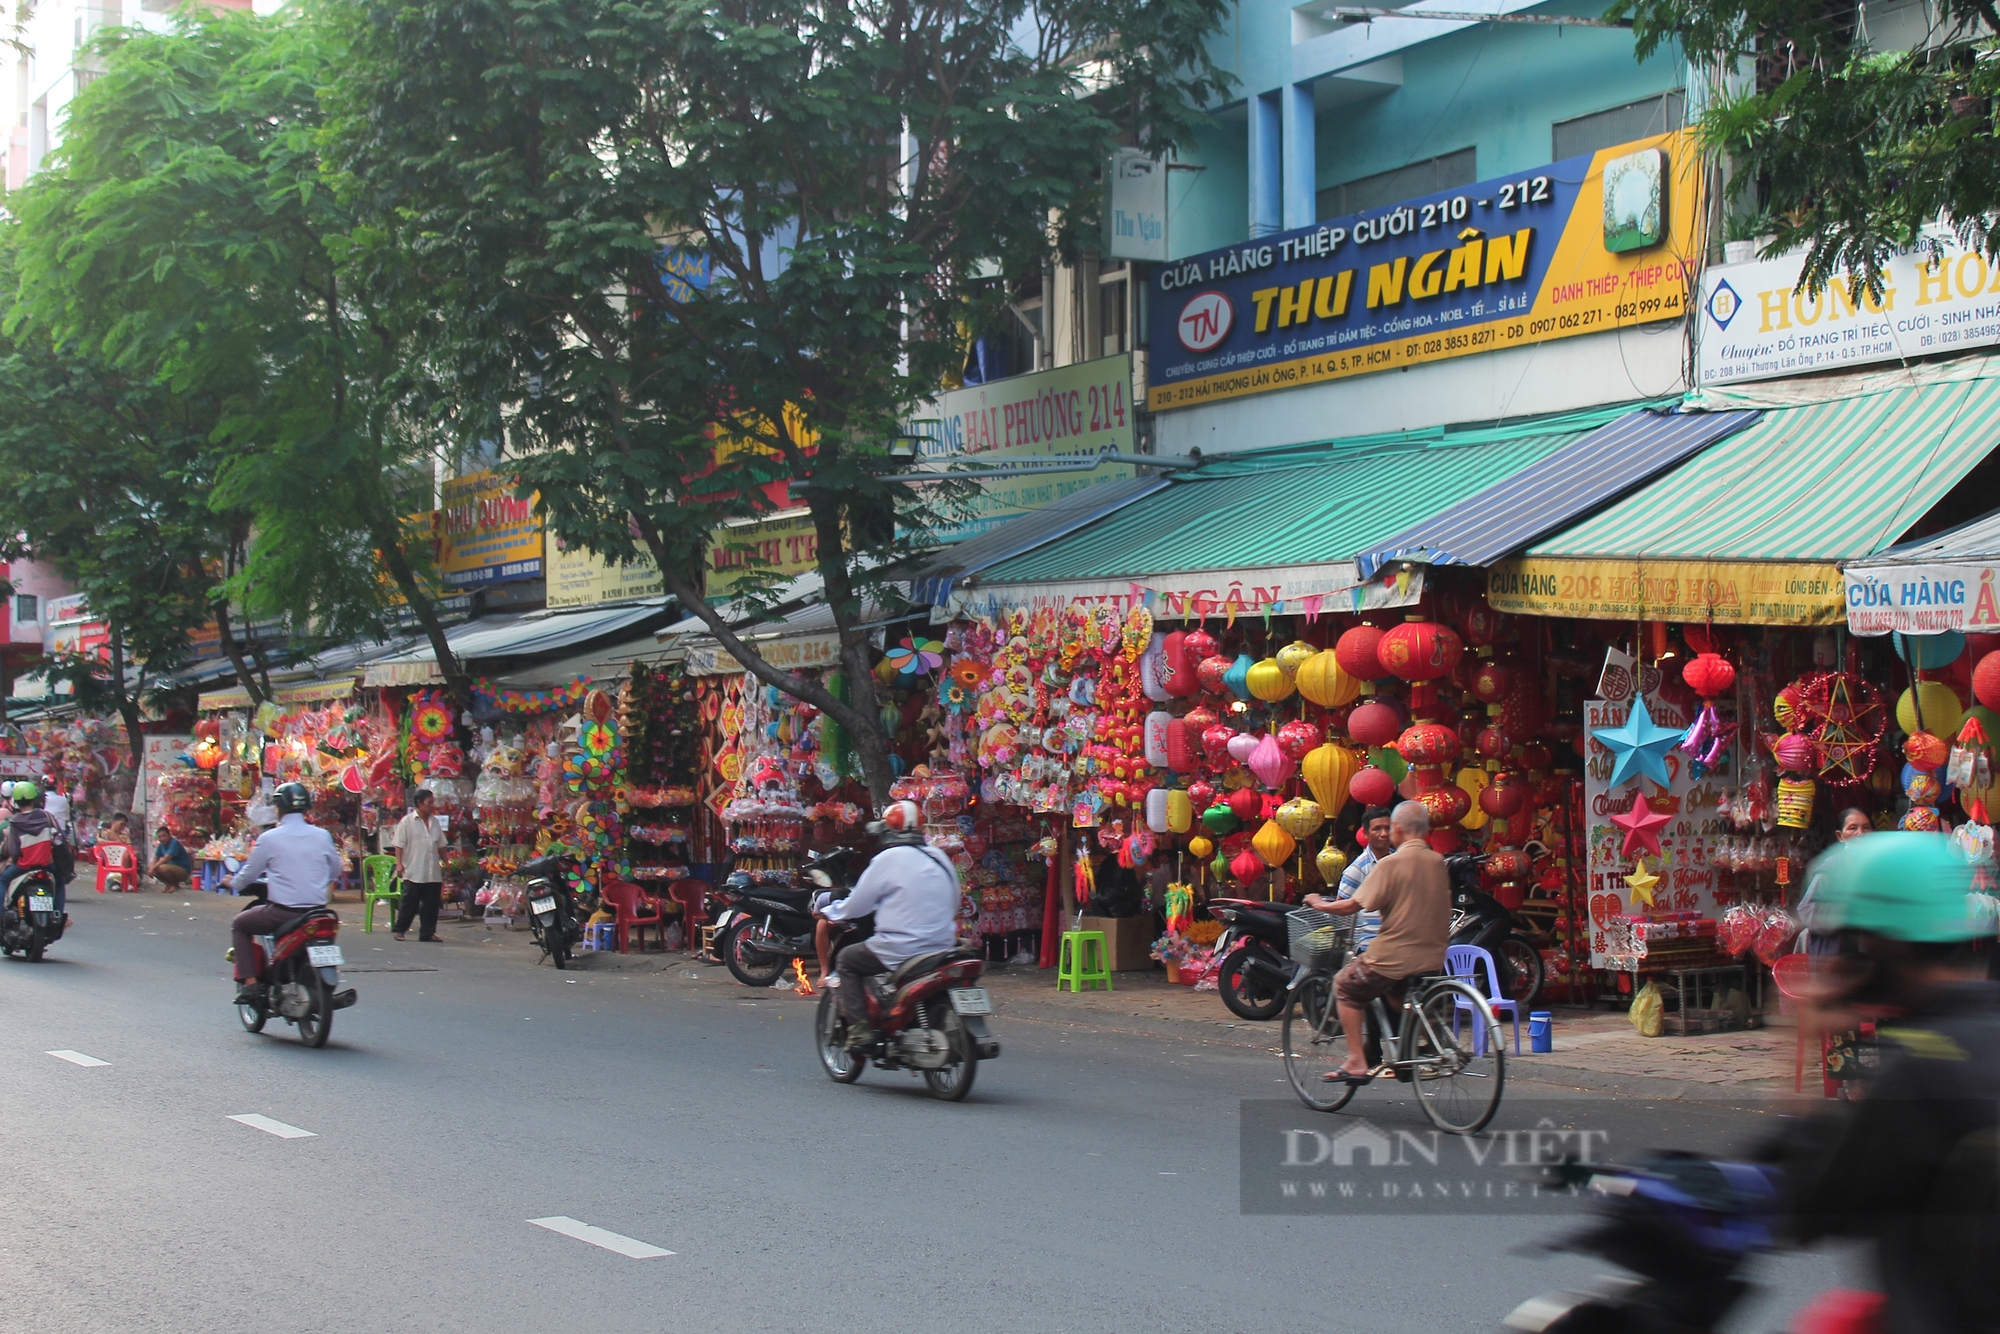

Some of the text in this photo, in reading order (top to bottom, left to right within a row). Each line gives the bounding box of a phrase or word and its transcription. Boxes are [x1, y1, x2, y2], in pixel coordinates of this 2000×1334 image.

[1160, 175, 1549, 291] CỬA HÀNG THIỆP CƯỚI 210 212
[1251, 226, 1531, 333] THU NGÂN
[1552, 281, 1584, 304] DANH
[1182, 299, 1221, 343] TN
[1412, 315, 1433, 328] HOA
[1440, 308, 1463, 324] NOEL
[1799, 331, 1839, 349] TRANG
[1841, 325, 1859, 342] TRÍ
[1861, 322, 1890, 340] TIỆC
[1897, 313, 1931, 333] CƯỚI
[1941, 309, 1971, 326] SINH
[1156, 391, 1172, 405] 210
[1179, 386, 1194, 400] 212
[1367, 349, 1391, 365] HCM
[1423, 340, 1442, 355] 028
[1444, 335, 1469, 351] 3853
[1471, 329, 1496, 346] 8271
[1530, 317, 1556, 335] 0907
[1559, 312, 1580, 330] 062
[1583, 308, 1602, 325] 271
[1614, 302, 1637, 319] 082
[1639, 297, 1661, 315] 999
[1664, 294, 1679, 309] 44
[1938, 331, 1961, 344] (028)
[1719, 366, 1733, 378] 208
[1003, 386, 1083, 452] PHƯỢNG
[1087, 380, 1125, 433] 214
[1161, 580, 1282, 616] NGÂN
[1490, 564, 1519, 595] CỬA
[1521, 568, 1557, 597] HÀNG
[1560, 575, 1602, 600] 208
[1685, 578, 1740, 606] HOA
[1848, 575, 1893, 607] CỬA
[1900, 575, 1965, 606] HÀNG
[803, 640, 831, 662] 214
